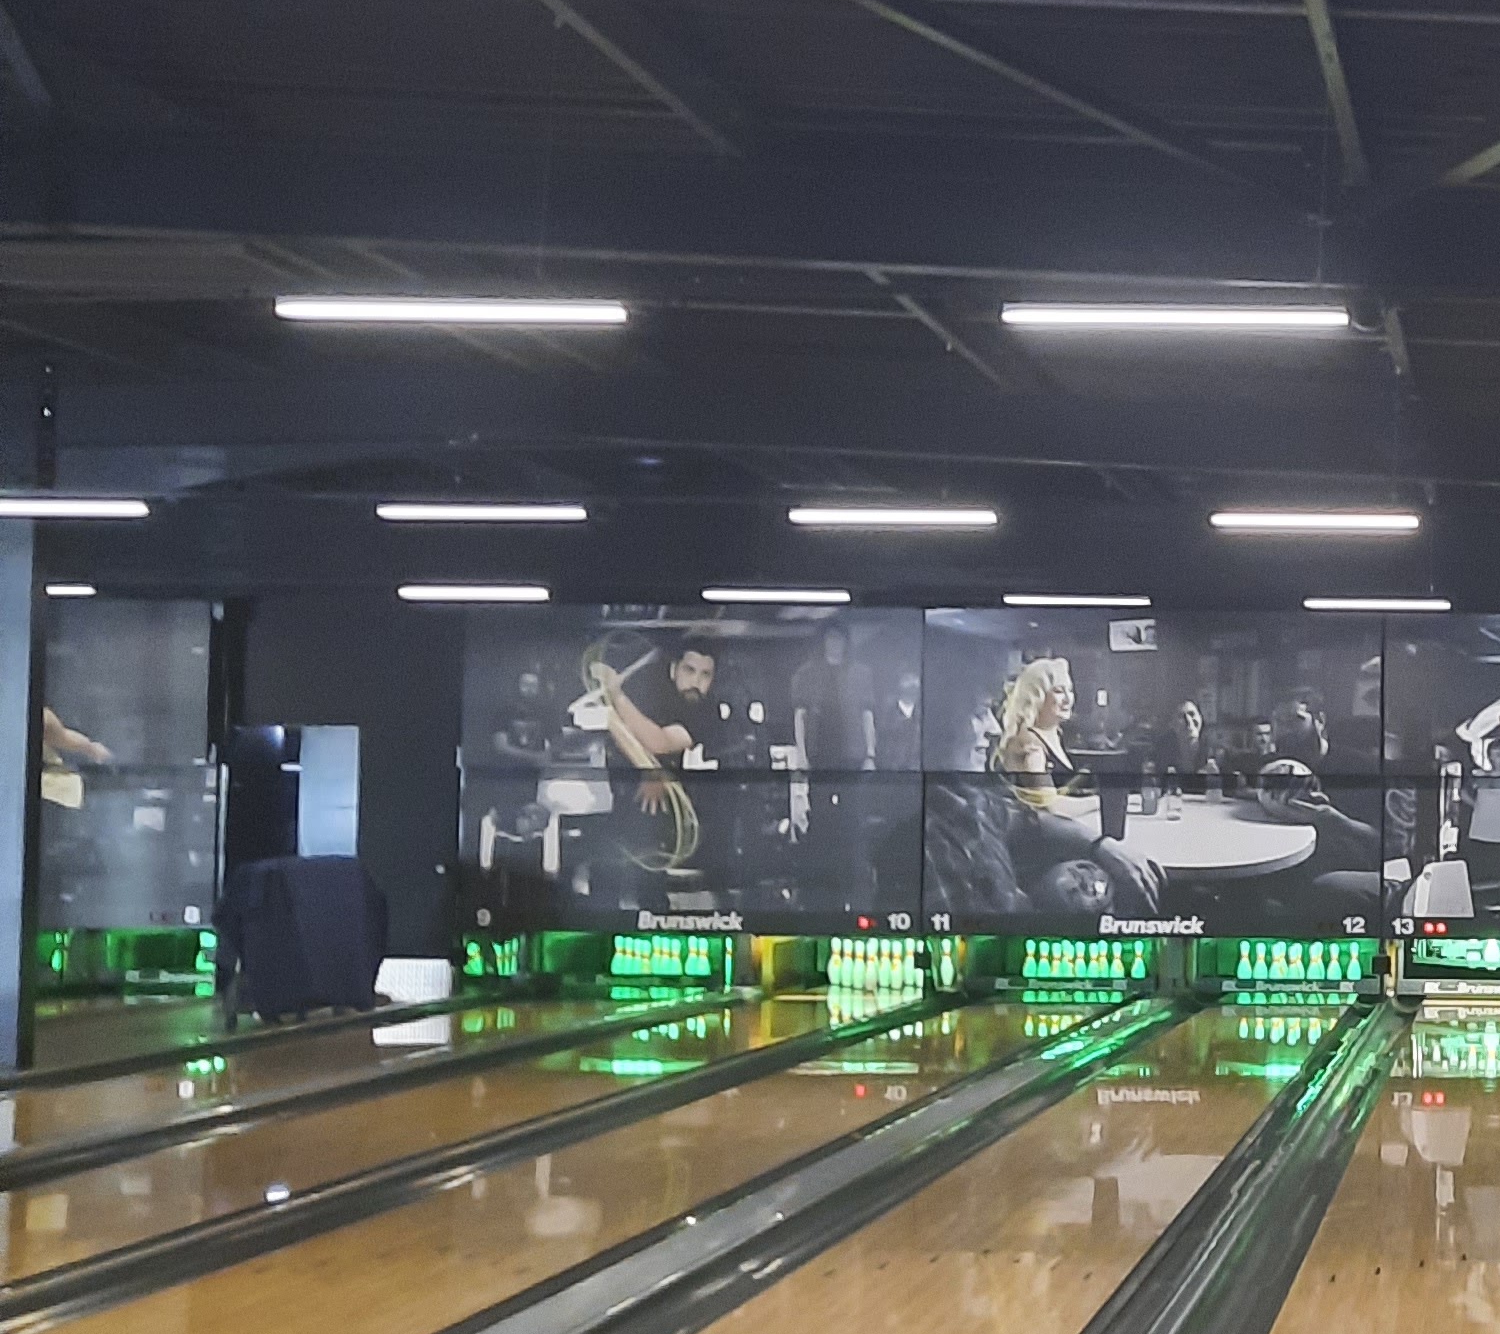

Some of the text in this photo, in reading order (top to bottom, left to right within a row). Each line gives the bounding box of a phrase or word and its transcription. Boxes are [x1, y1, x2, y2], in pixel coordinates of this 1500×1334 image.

[637, 911, 911, 931] Brunswick 10
[931, 913, 1366, 935] 11 Brunswick 12
[1391, 918, 1415, 935] 13
